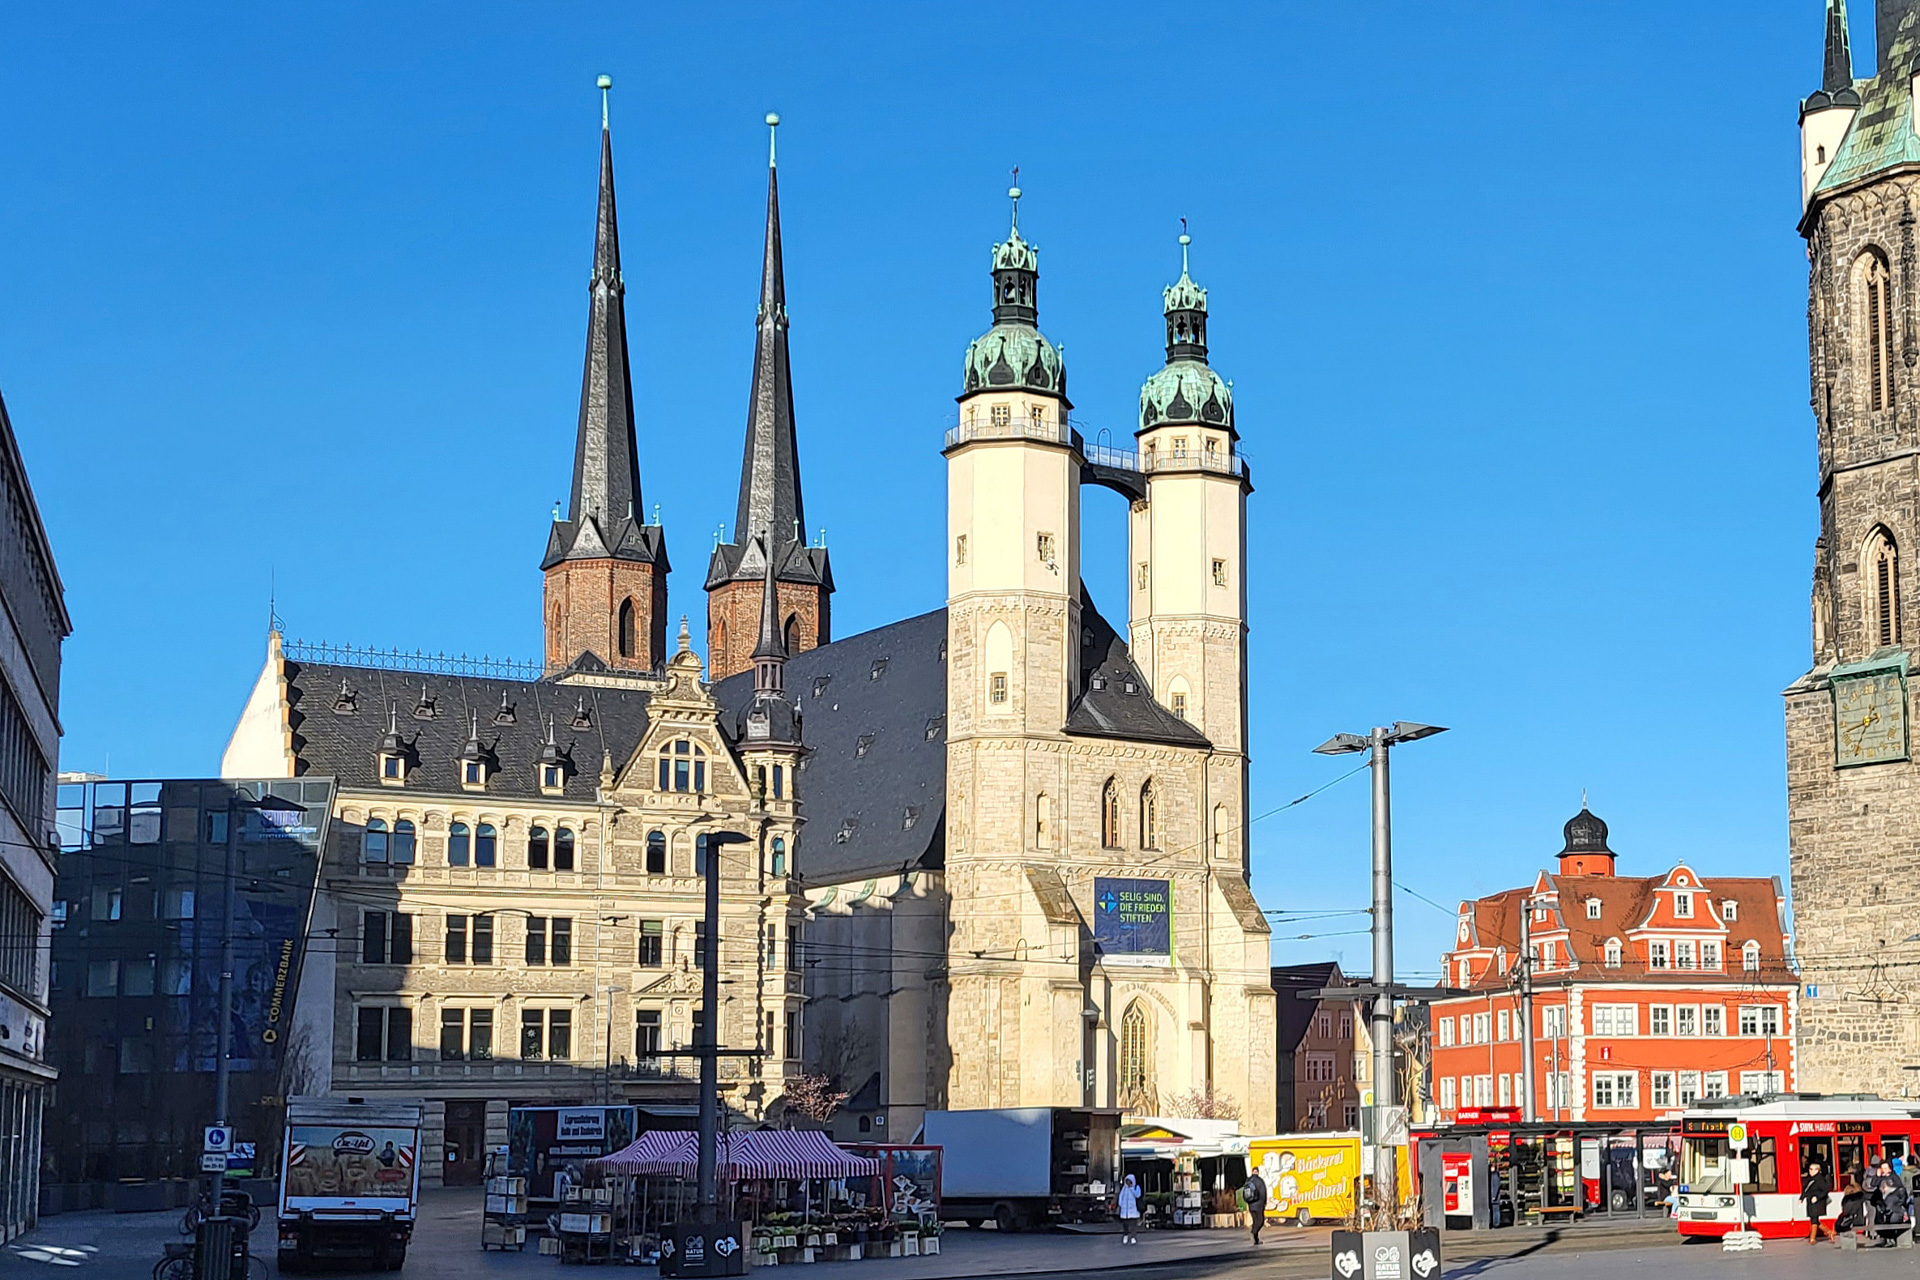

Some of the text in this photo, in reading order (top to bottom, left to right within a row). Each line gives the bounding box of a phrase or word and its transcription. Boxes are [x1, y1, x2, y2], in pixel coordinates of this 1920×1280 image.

[1120, 892, 1141, 901] SELIG
[1120, 903, 1166, 912] DIE FRIEDEN
[1120, 914, 1154, 923] STIFTEN.
[269, 939, 293, 1022] COMMERZBANK
